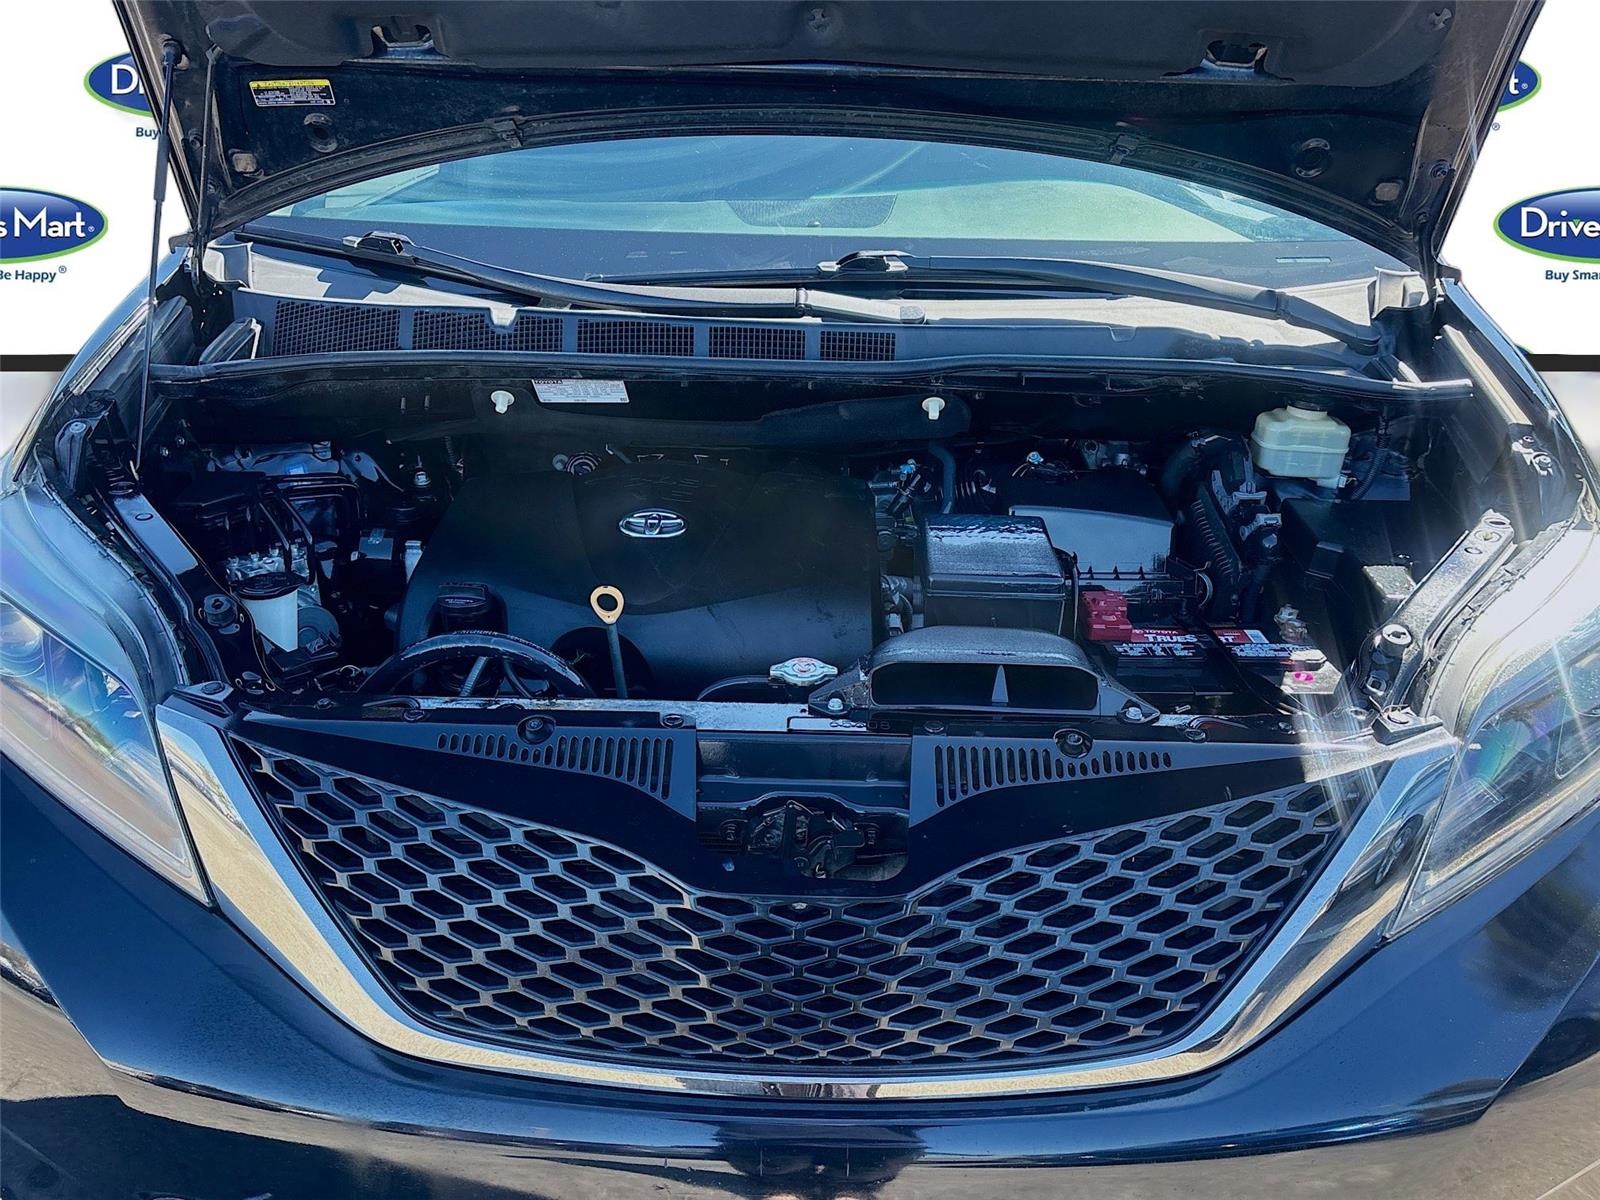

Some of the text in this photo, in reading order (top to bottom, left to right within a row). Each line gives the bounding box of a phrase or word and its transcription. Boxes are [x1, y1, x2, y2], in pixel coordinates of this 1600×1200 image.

[14, 206, 86, 237] Mart
[1521, 207, 1600, 238] Drive
[15, 270, 57, 283] Happy
[1545, 269, 1600, 283] Buy Sma
